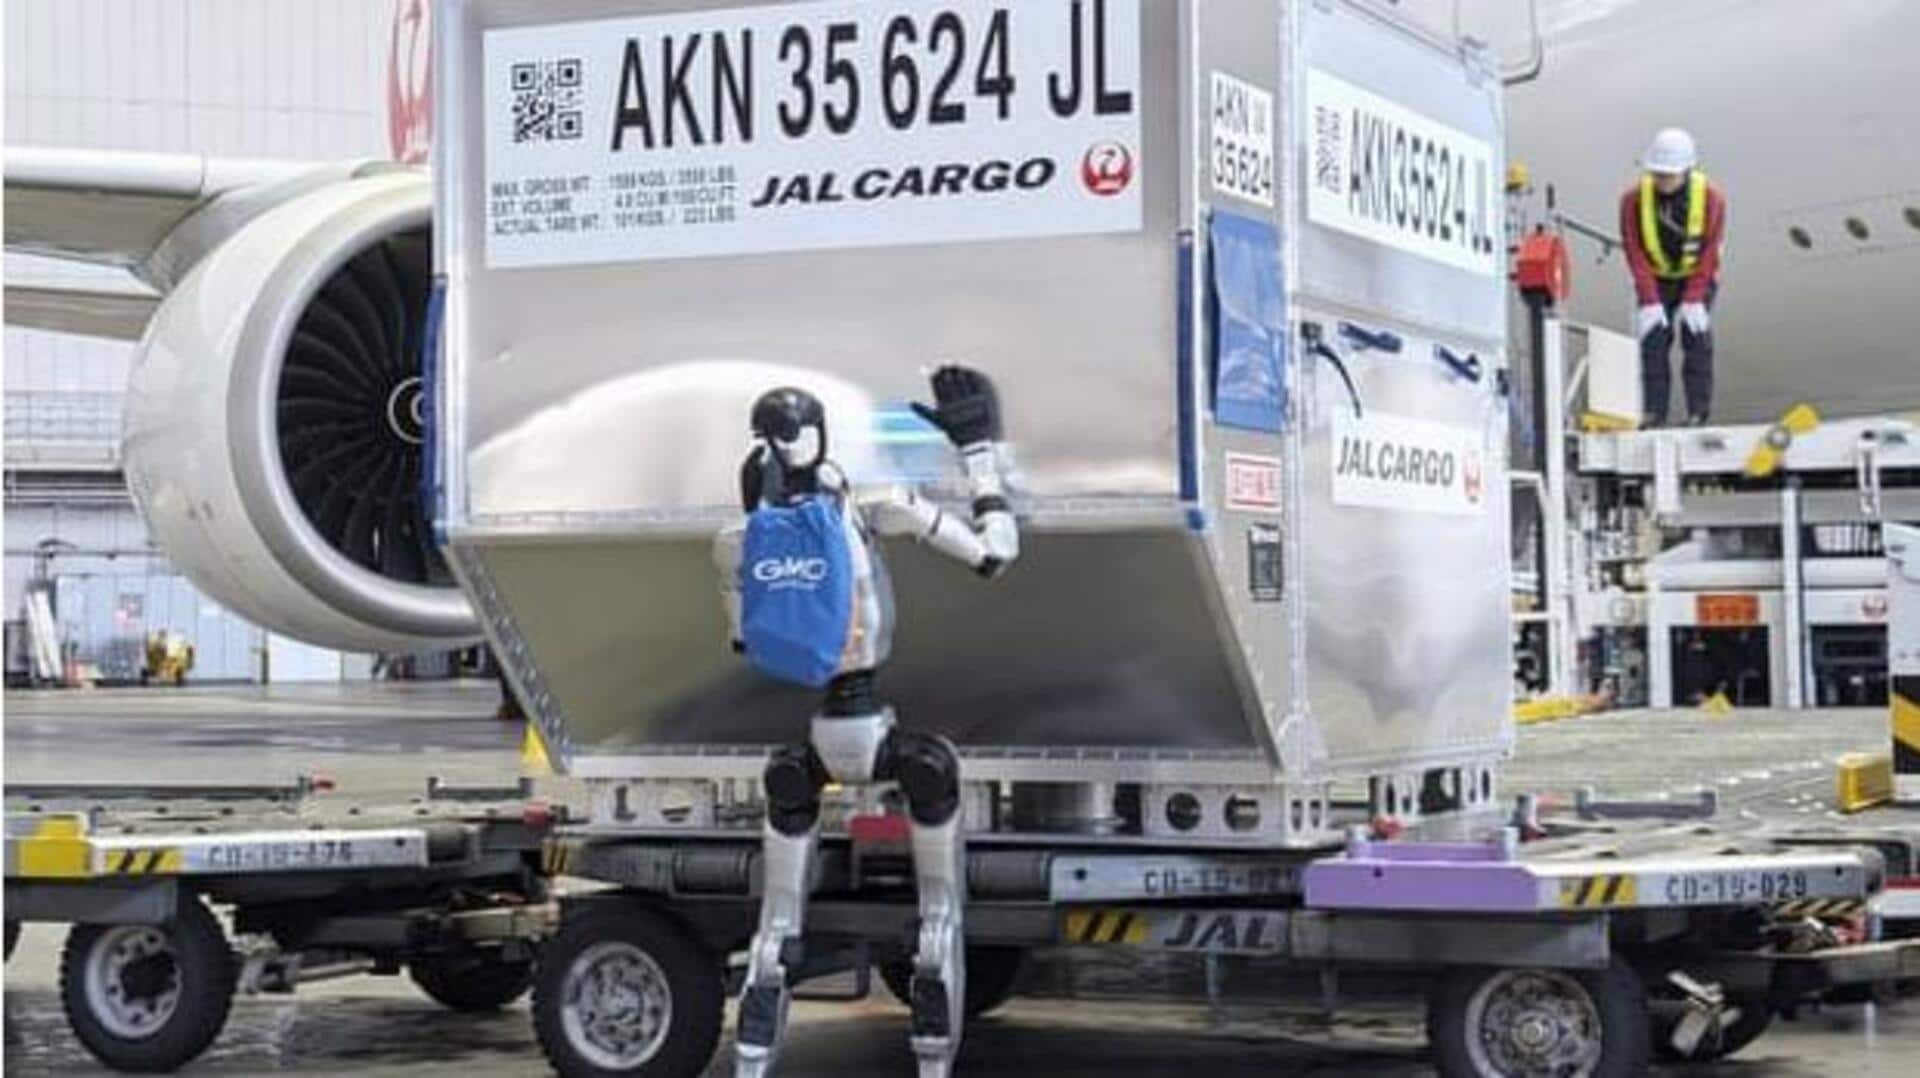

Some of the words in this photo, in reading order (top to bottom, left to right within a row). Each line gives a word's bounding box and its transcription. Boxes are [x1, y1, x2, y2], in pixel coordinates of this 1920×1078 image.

[610, 28, 753, 151] AKN
[777, 22, 860, 138] 35
[881, 9, 1015, 131] 624
[1047, 0, 1133, 118] JL
[1215, 136, 1272, 197] 35624
[1164, 912, 1276, 949] JAL
